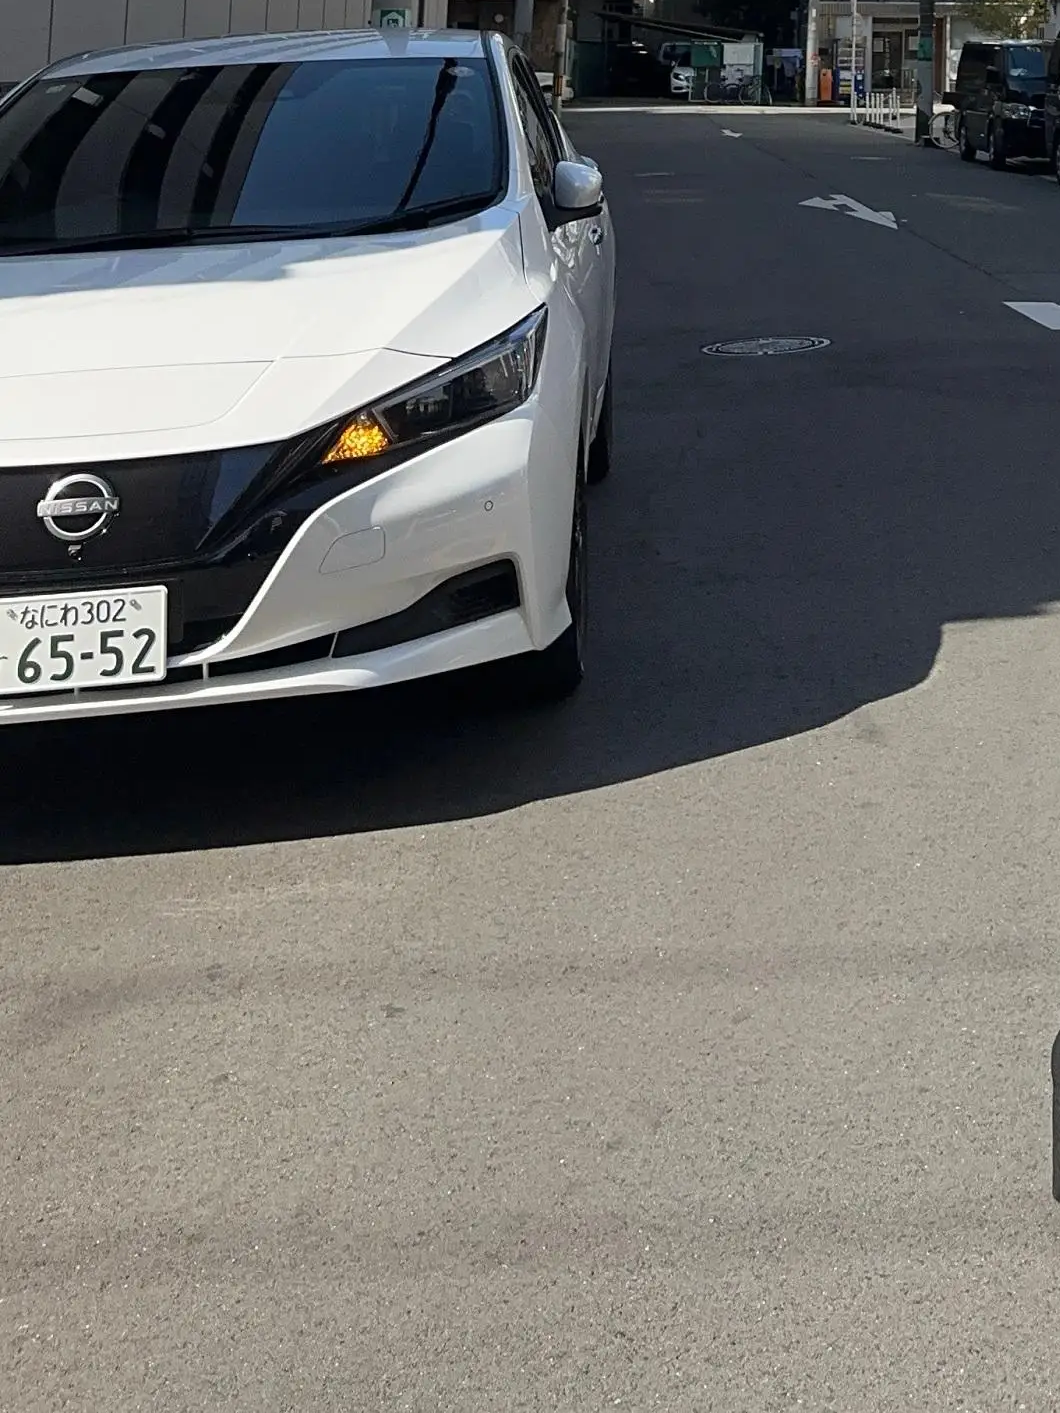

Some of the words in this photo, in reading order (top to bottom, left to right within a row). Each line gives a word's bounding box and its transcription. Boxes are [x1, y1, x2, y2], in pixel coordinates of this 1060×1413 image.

[38, 497, 119, 516] NISSAN
[20, 598, 127, 630] なにわ302
[16, 626, 157, 685] 65-52
